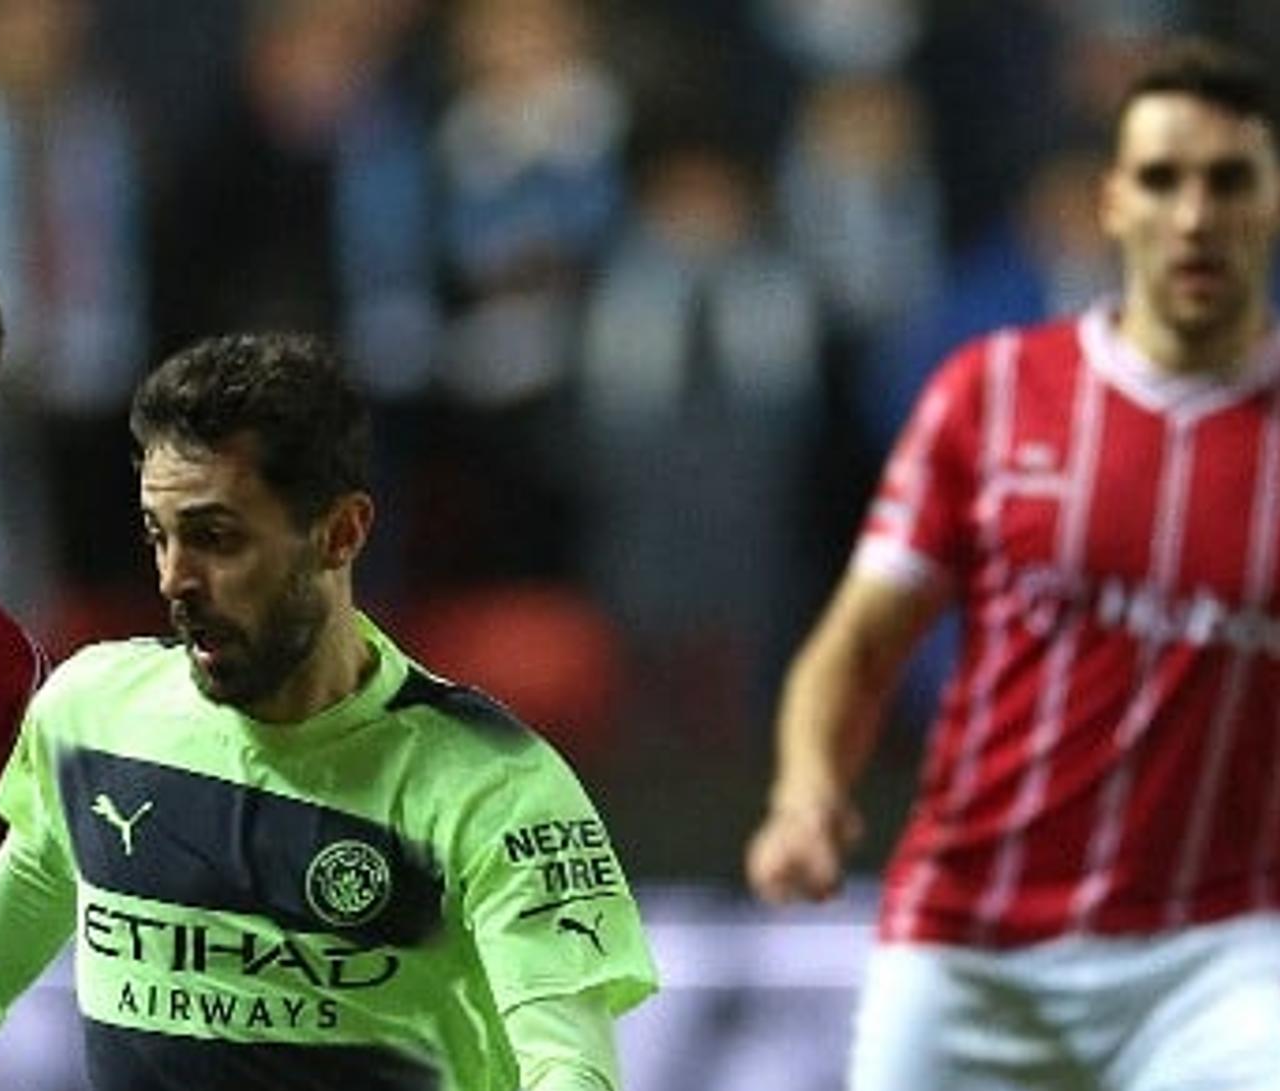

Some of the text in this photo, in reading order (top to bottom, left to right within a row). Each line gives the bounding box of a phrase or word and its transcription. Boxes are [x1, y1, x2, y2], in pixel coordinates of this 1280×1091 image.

[504, 820, 599, 862] NEXE
[535, 855, 617, 892] TIRE
[85, 904, 398, 989] ETIHAD
[119, 983, 338, 1028] AIRWAYS
